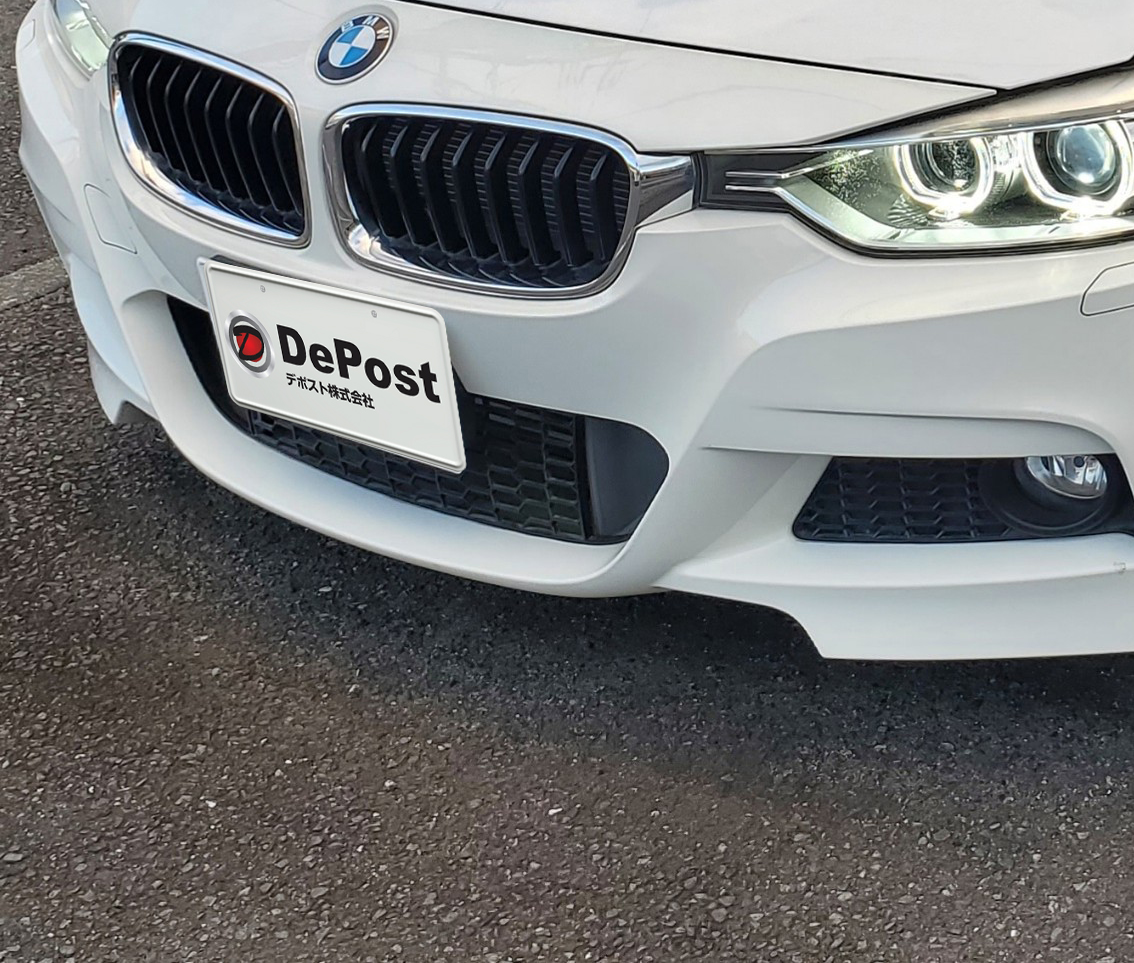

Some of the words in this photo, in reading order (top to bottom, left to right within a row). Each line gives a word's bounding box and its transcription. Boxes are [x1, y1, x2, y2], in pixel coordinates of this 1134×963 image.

[341, 15, 390, 40] BMW
[276, 324, 441, 404] DePost
[286, 372, 375, 409] デポスト株式会社
